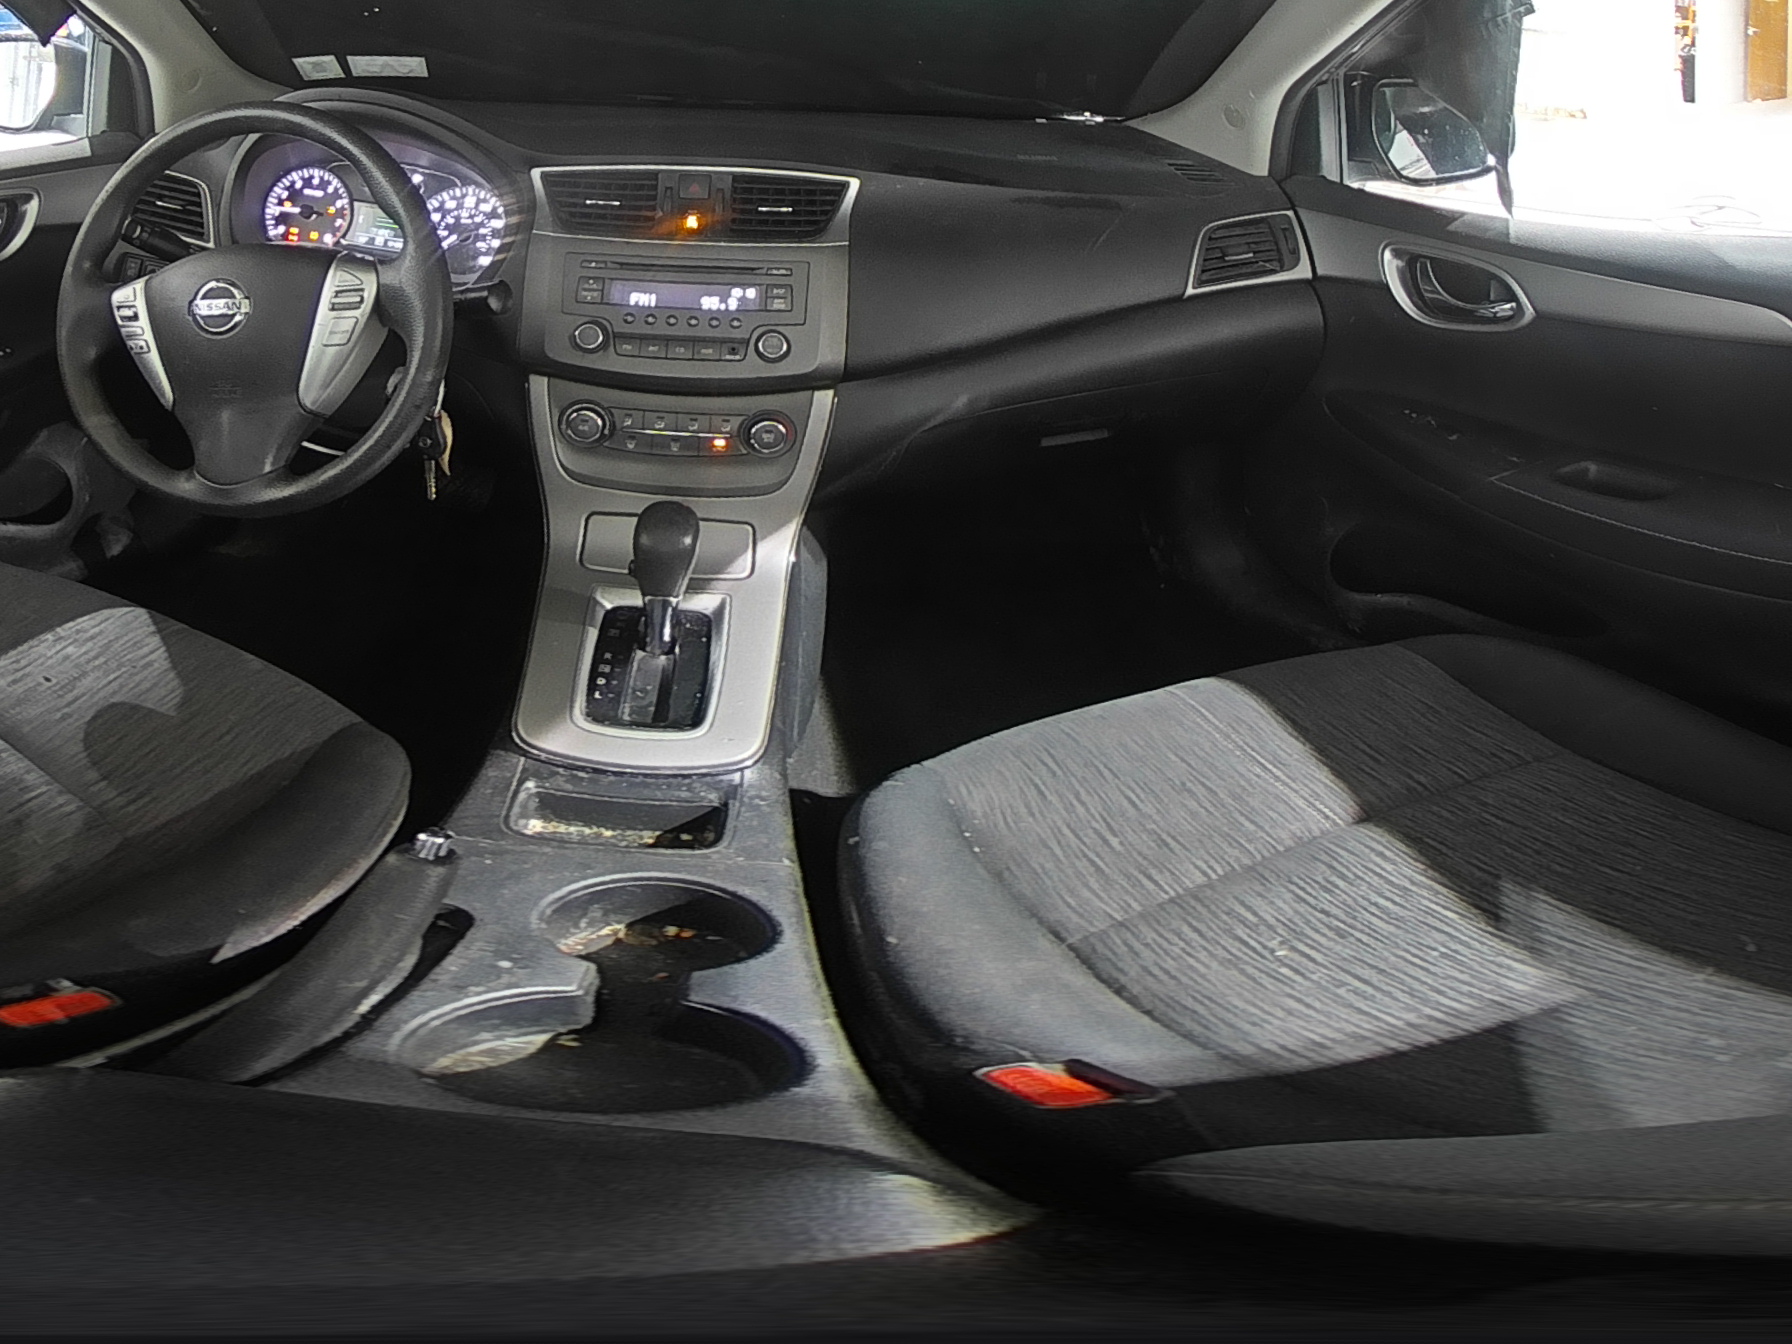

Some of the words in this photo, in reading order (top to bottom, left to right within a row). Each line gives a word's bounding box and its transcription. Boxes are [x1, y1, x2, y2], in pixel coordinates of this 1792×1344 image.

[194, 300, 242, 313] NISSAN
[629, 292, 657, 307] FM1
[700, 295, 738, 311] 95.9
